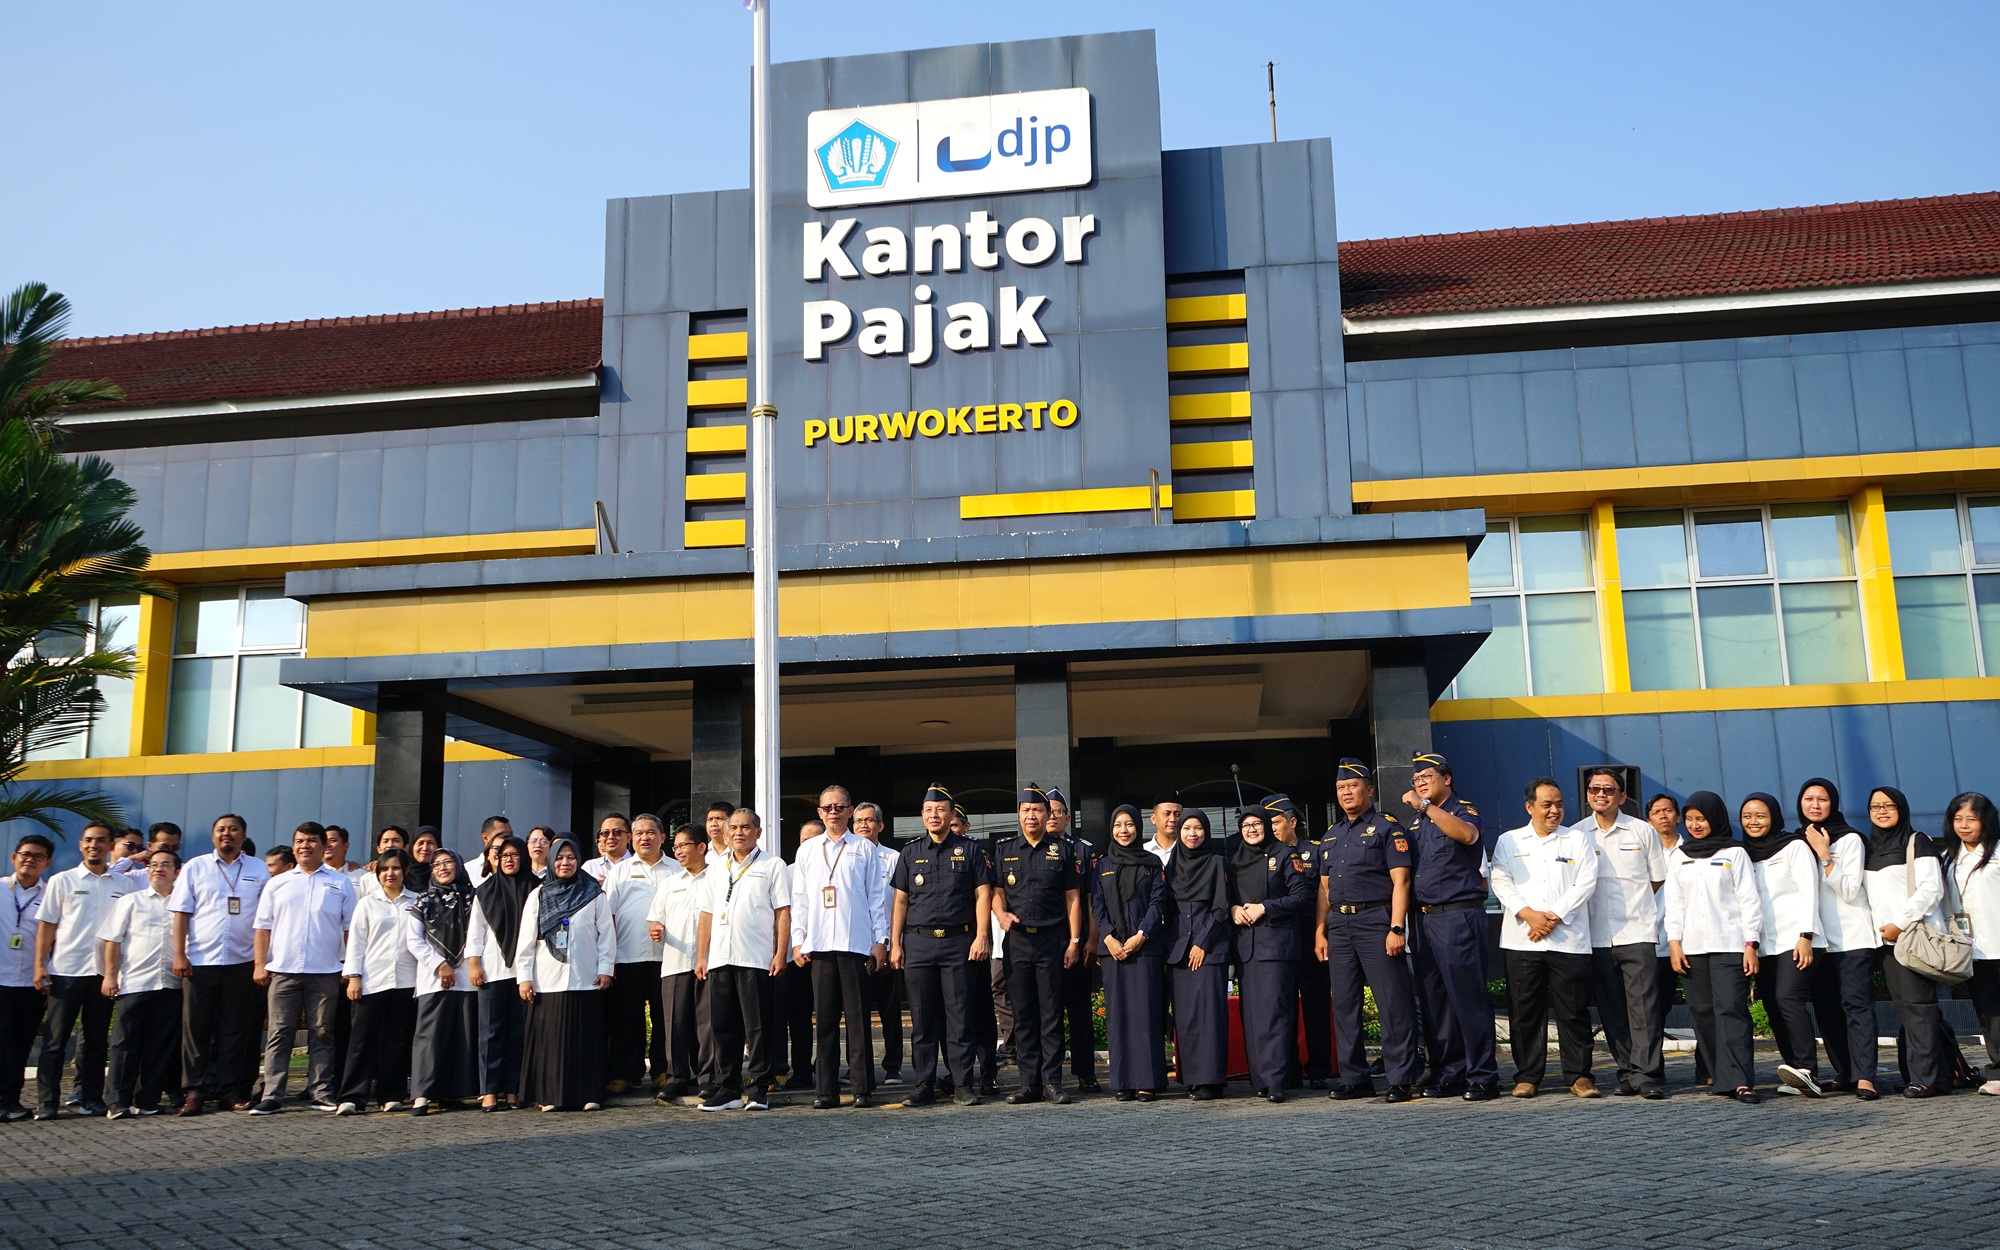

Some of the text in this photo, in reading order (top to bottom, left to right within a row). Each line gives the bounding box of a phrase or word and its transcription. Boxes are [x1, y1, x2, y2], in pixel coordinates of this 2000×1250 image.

[997, 116, 1071, 167] djp
[803, 210, 1096, 281] Kantor
[803, 284, 1049, 366] Pajak
[804, 399, 1079, 447] PURWOKERTO
